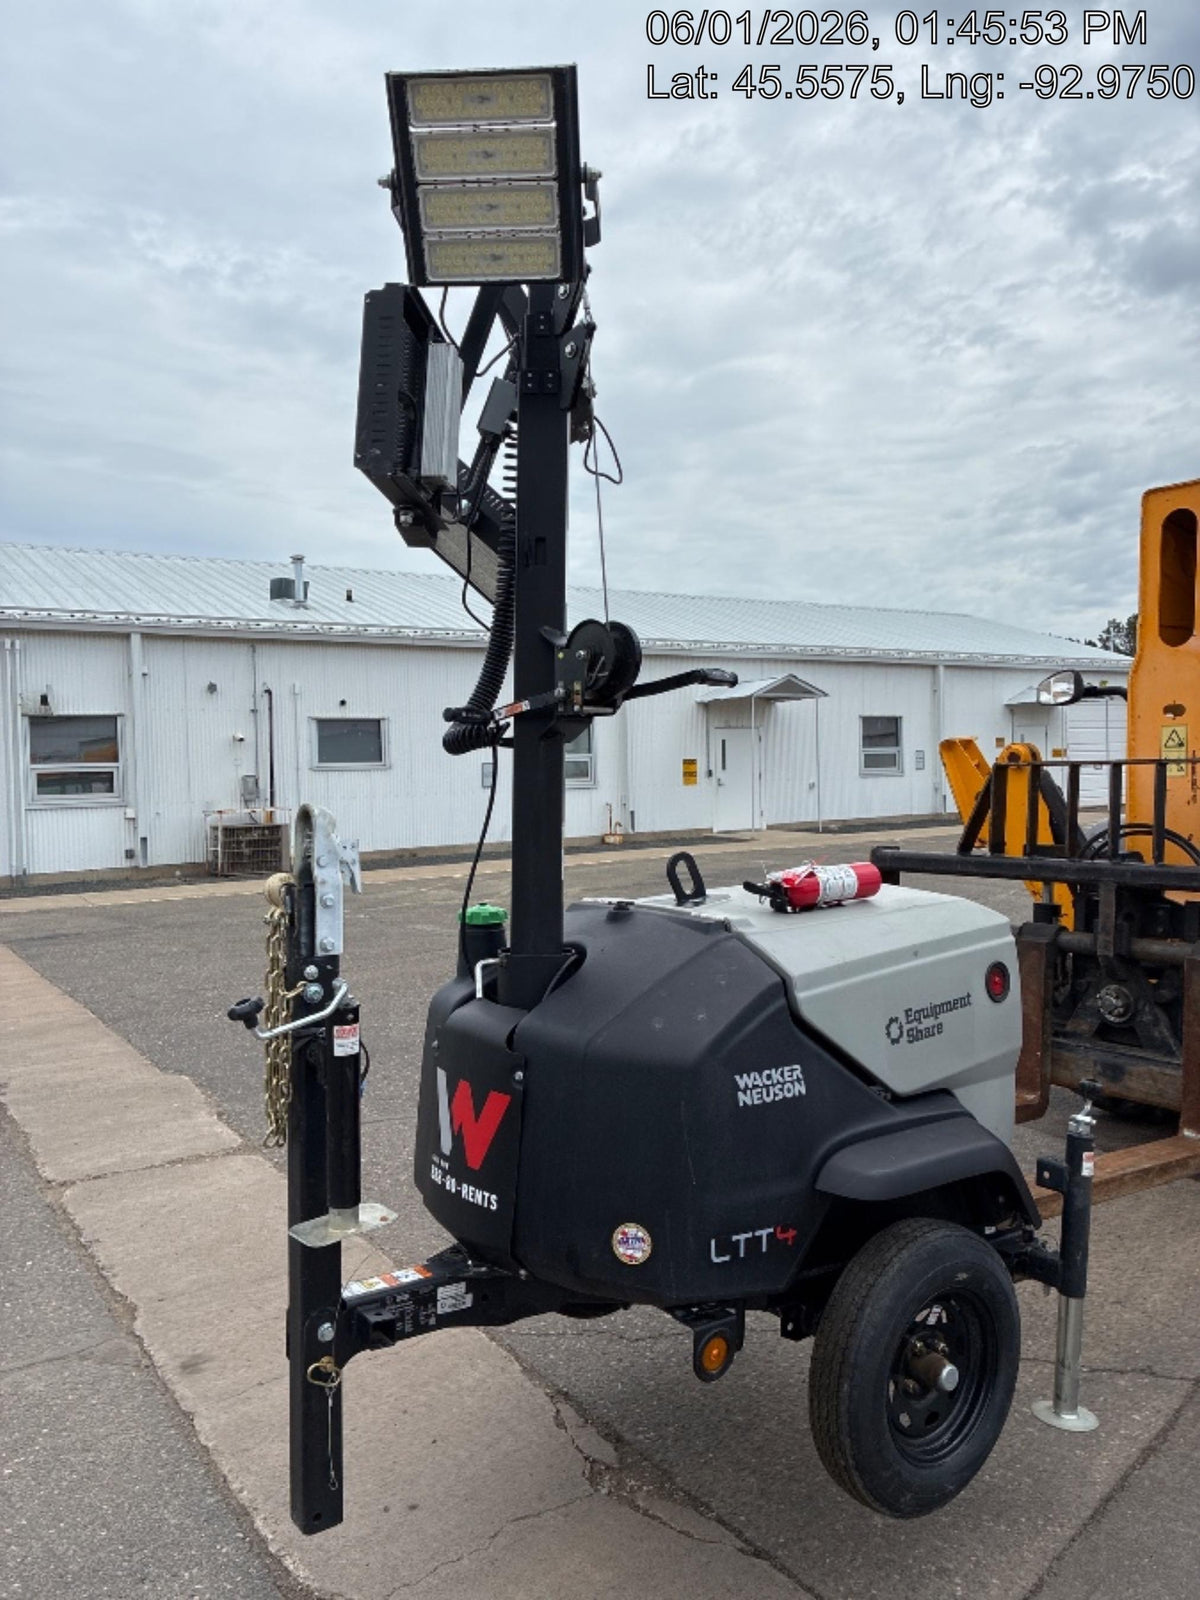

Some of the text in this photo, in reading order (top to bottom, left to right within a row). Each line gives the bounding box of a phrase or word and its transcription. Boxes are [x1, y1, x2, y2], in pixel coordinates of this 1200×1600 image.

[904, 992, 972, 1025] Equipment
[906, 1022, 944, 1044] Share
[734, 1064, 803, 1090] WACKER
[738, 1080, 807, 1107] NEUSON
[710, 1226, 798, 1263] LTT4
